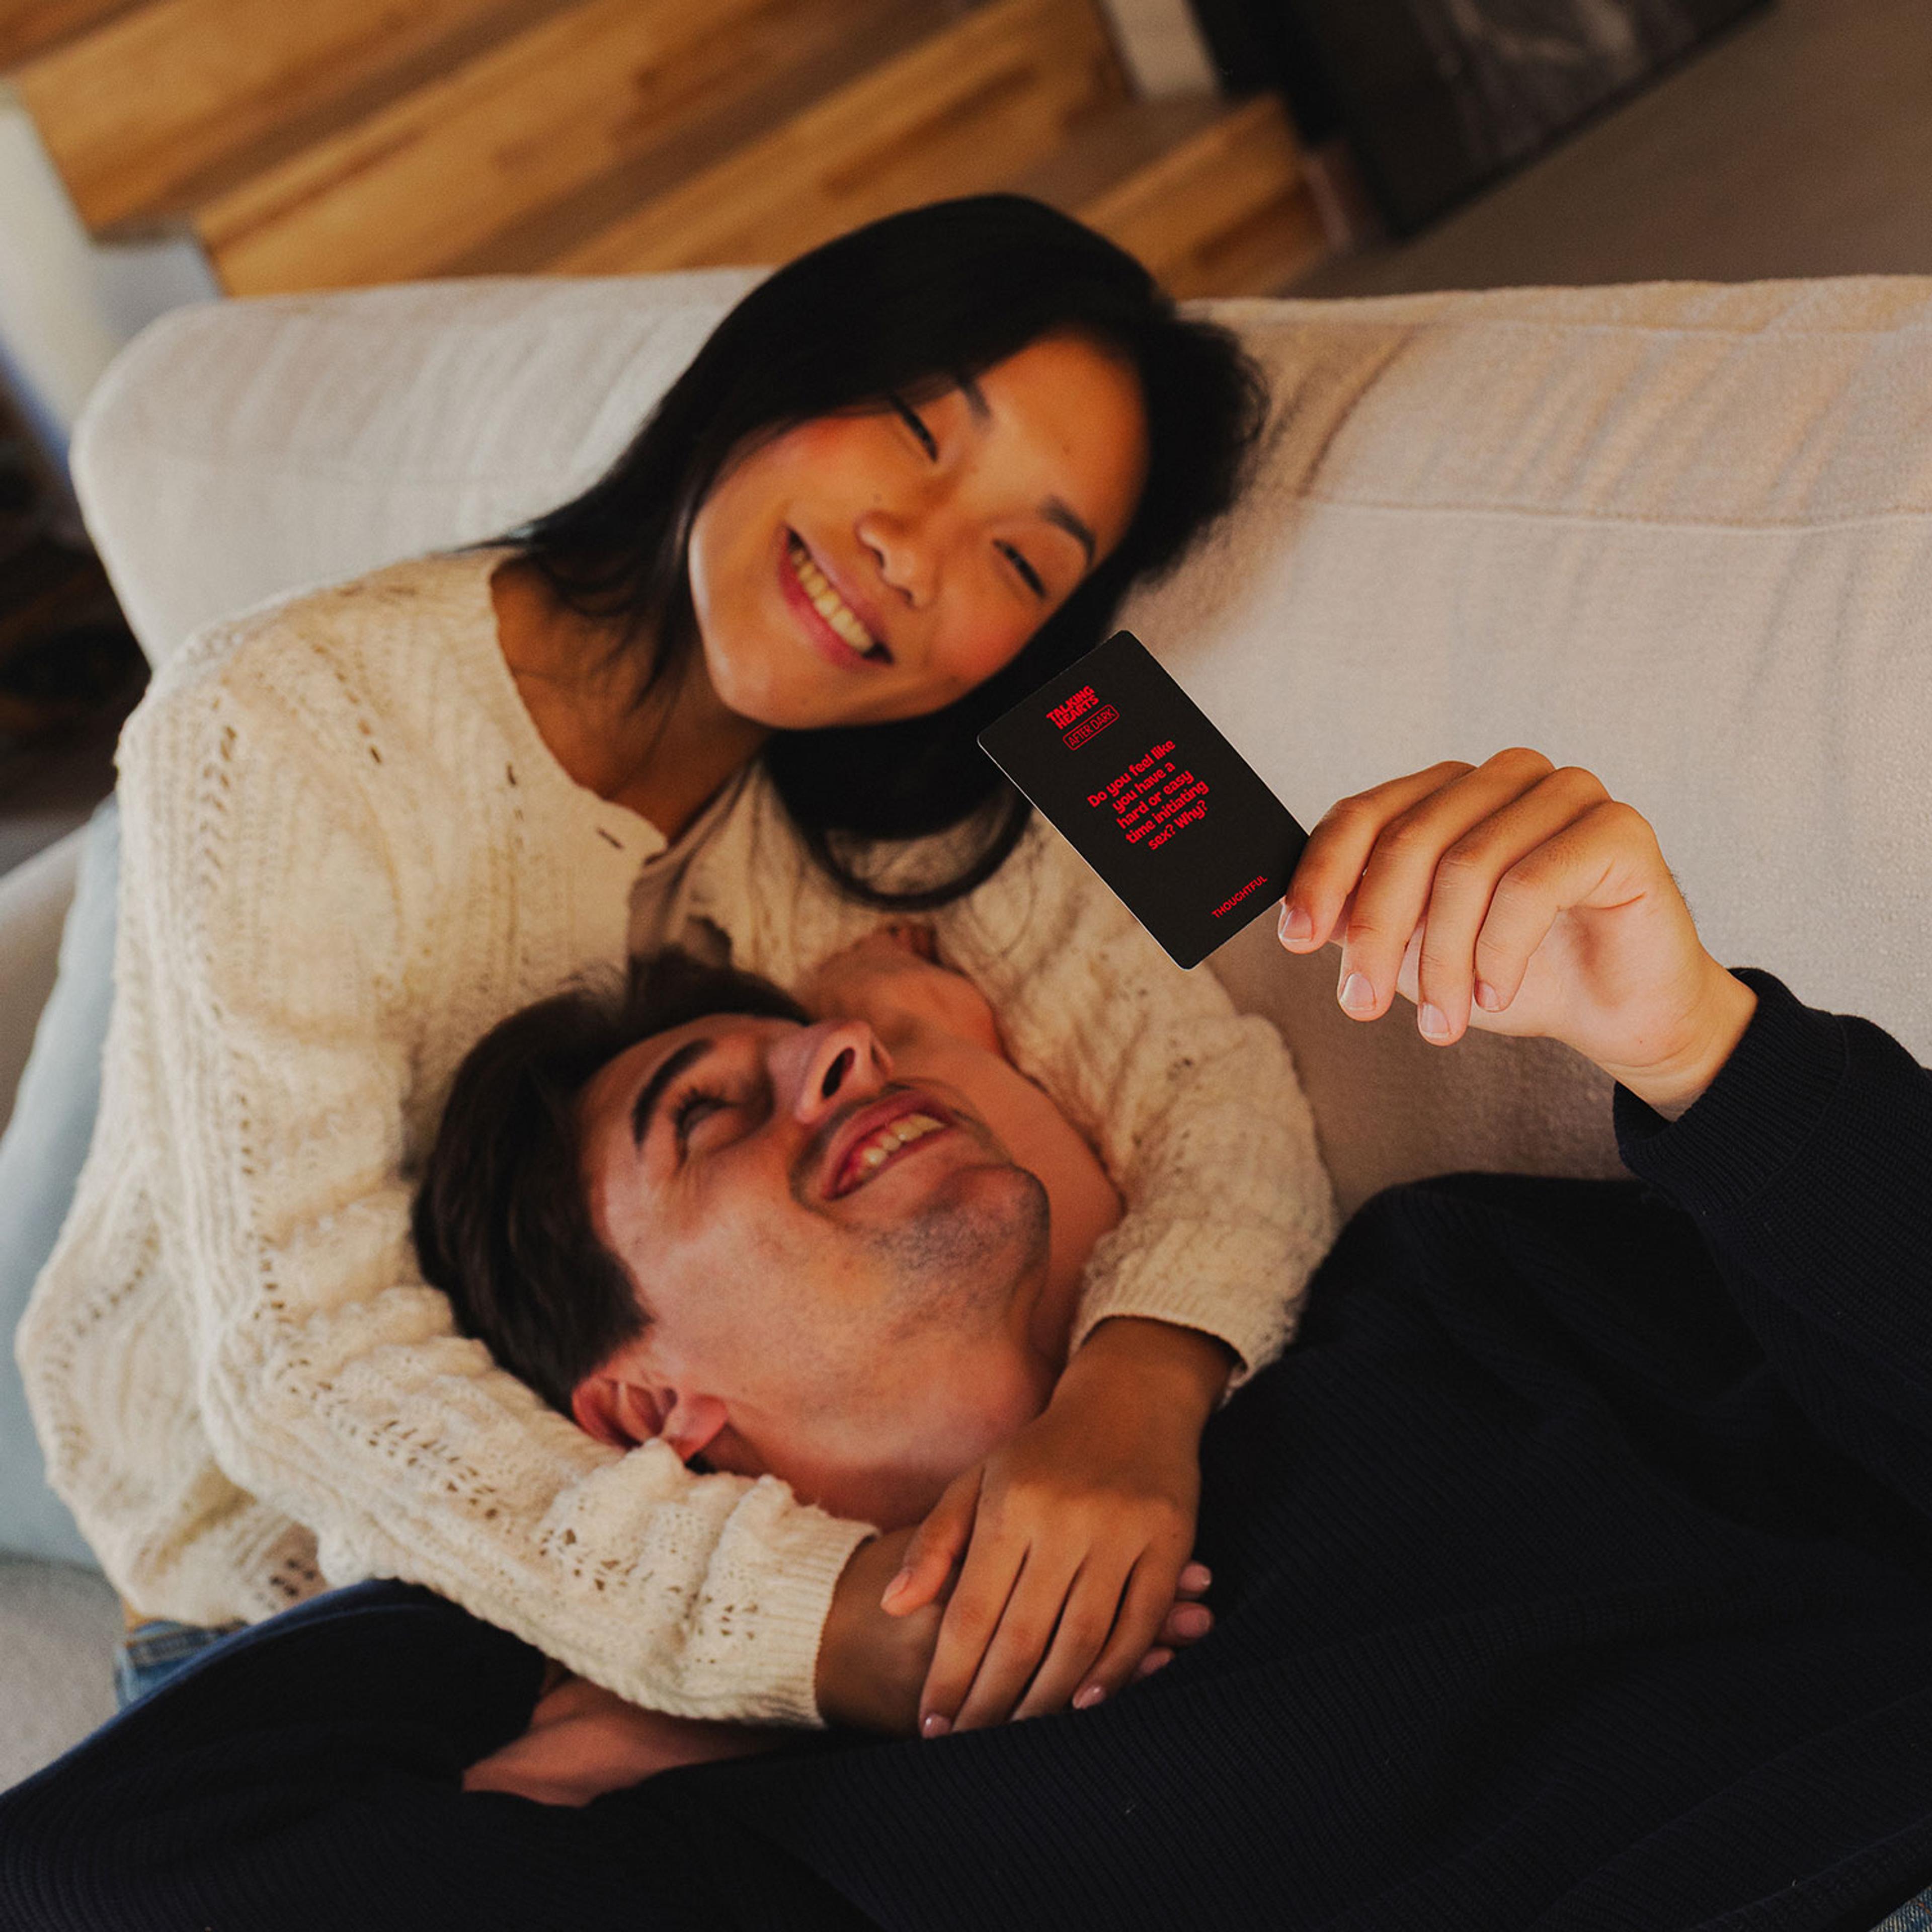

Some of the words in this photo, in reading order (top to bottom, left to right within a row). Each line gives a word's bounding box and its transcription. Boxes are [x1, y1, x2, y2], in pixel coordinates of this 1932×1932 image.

[1046, 686, 1095, 722] TALKING
[1055, 694, 1099, 729] HEARTS
[1069, 725, 1093, 746] AFTER
[1090, 708, 1115, 730] DARK
[1087, 791, 1107, 807] Do
[1106, 773, 1132, 797] you
[1129, 753, 1154, 776] feel
[1151, 741, 1175, 760] like
[1112, 790, 1138, 814] you
[1134, 769, 1166, 794] have
[1165, 762, 1175, 773] a
[1116, 800, 1149, 829] hard
[1148, 791, 1162, 806] or
[1163, 771, 1194, 794] easy
[1125, 820, 1156, 844] time
[1152, 781, 1210, 824] initiating
[1148, 824, 1175, 850] sex?
[1173, 800, 1208, 829] Why?
[1212, 876, 1267, 918] THOUGHTFUL
